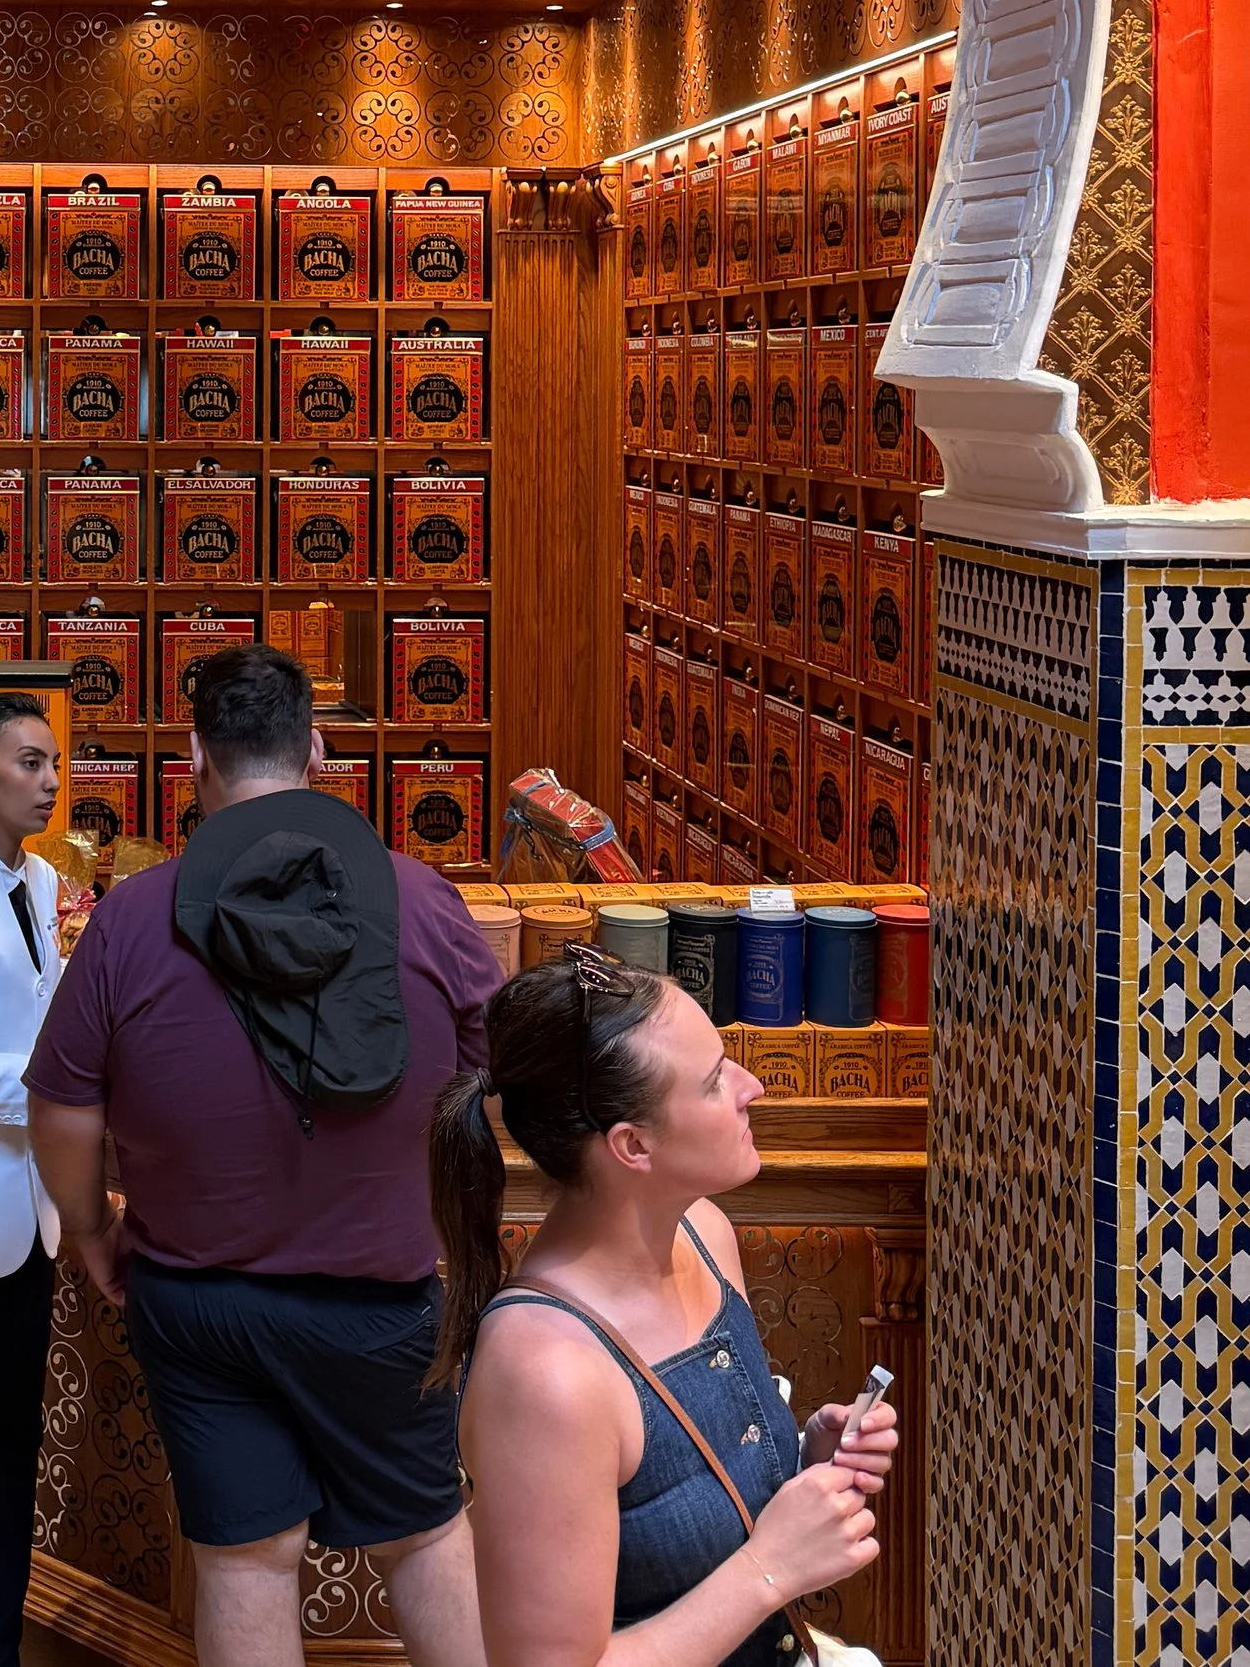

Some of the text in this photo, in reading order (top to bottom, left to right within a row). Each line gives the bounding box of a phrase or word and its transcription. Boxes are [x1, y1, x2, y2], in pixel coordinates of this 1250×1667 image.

[868, 107, 912, 132] IVORY COAST
[818, 126, 850, 146] MYANMAR
[772, 142, 797, 158] MALAWI
[68, 196, 120, 207] BRAZIL
[182, 196, 236, 208] ZAMBIA
[297, 198, 351, 210] ANGOLA
[304, 250, 344, 272] BACHA
[417, 251, 458, 273] BACHA
[820, 329, 845, 341] MEXICO
[65, 338, 122, 349] PANAMA
[187, 340, 233, 348] HAWAII
[302, 339, 348, 350] HAWAII
[399, 340, 475, 351] AUSTRALIA
[190, 390, 230, 412] BACHA
[167, 480, 251, 490] EL SALVADOR
[289, 480, 360, 491] HONDURAS
[411, 480, 466, 491] BOLIVIA
[770, 518, 796, 533] ETHIOPIA
[812, 525, 851, 542] MADAGASCAR
[72, 531, 113, 554] BACHA
[189, 531, 230, 554] BACHA
[874, 536, 899, 553] KENYA
[79, 550, 108, 558] COFFEE
[58, 621, 127, 632] TANZANIA
[819, 722, 840, 741] NEPAL
[865, 740, 905, 770] NICARAGUA
[71, 765, 108, 774] INICAN
[321, 763, 353, 773] ADOR
[421, 764, 453, 772] PERU
[831, 1072, 871, 1094] BACHA
